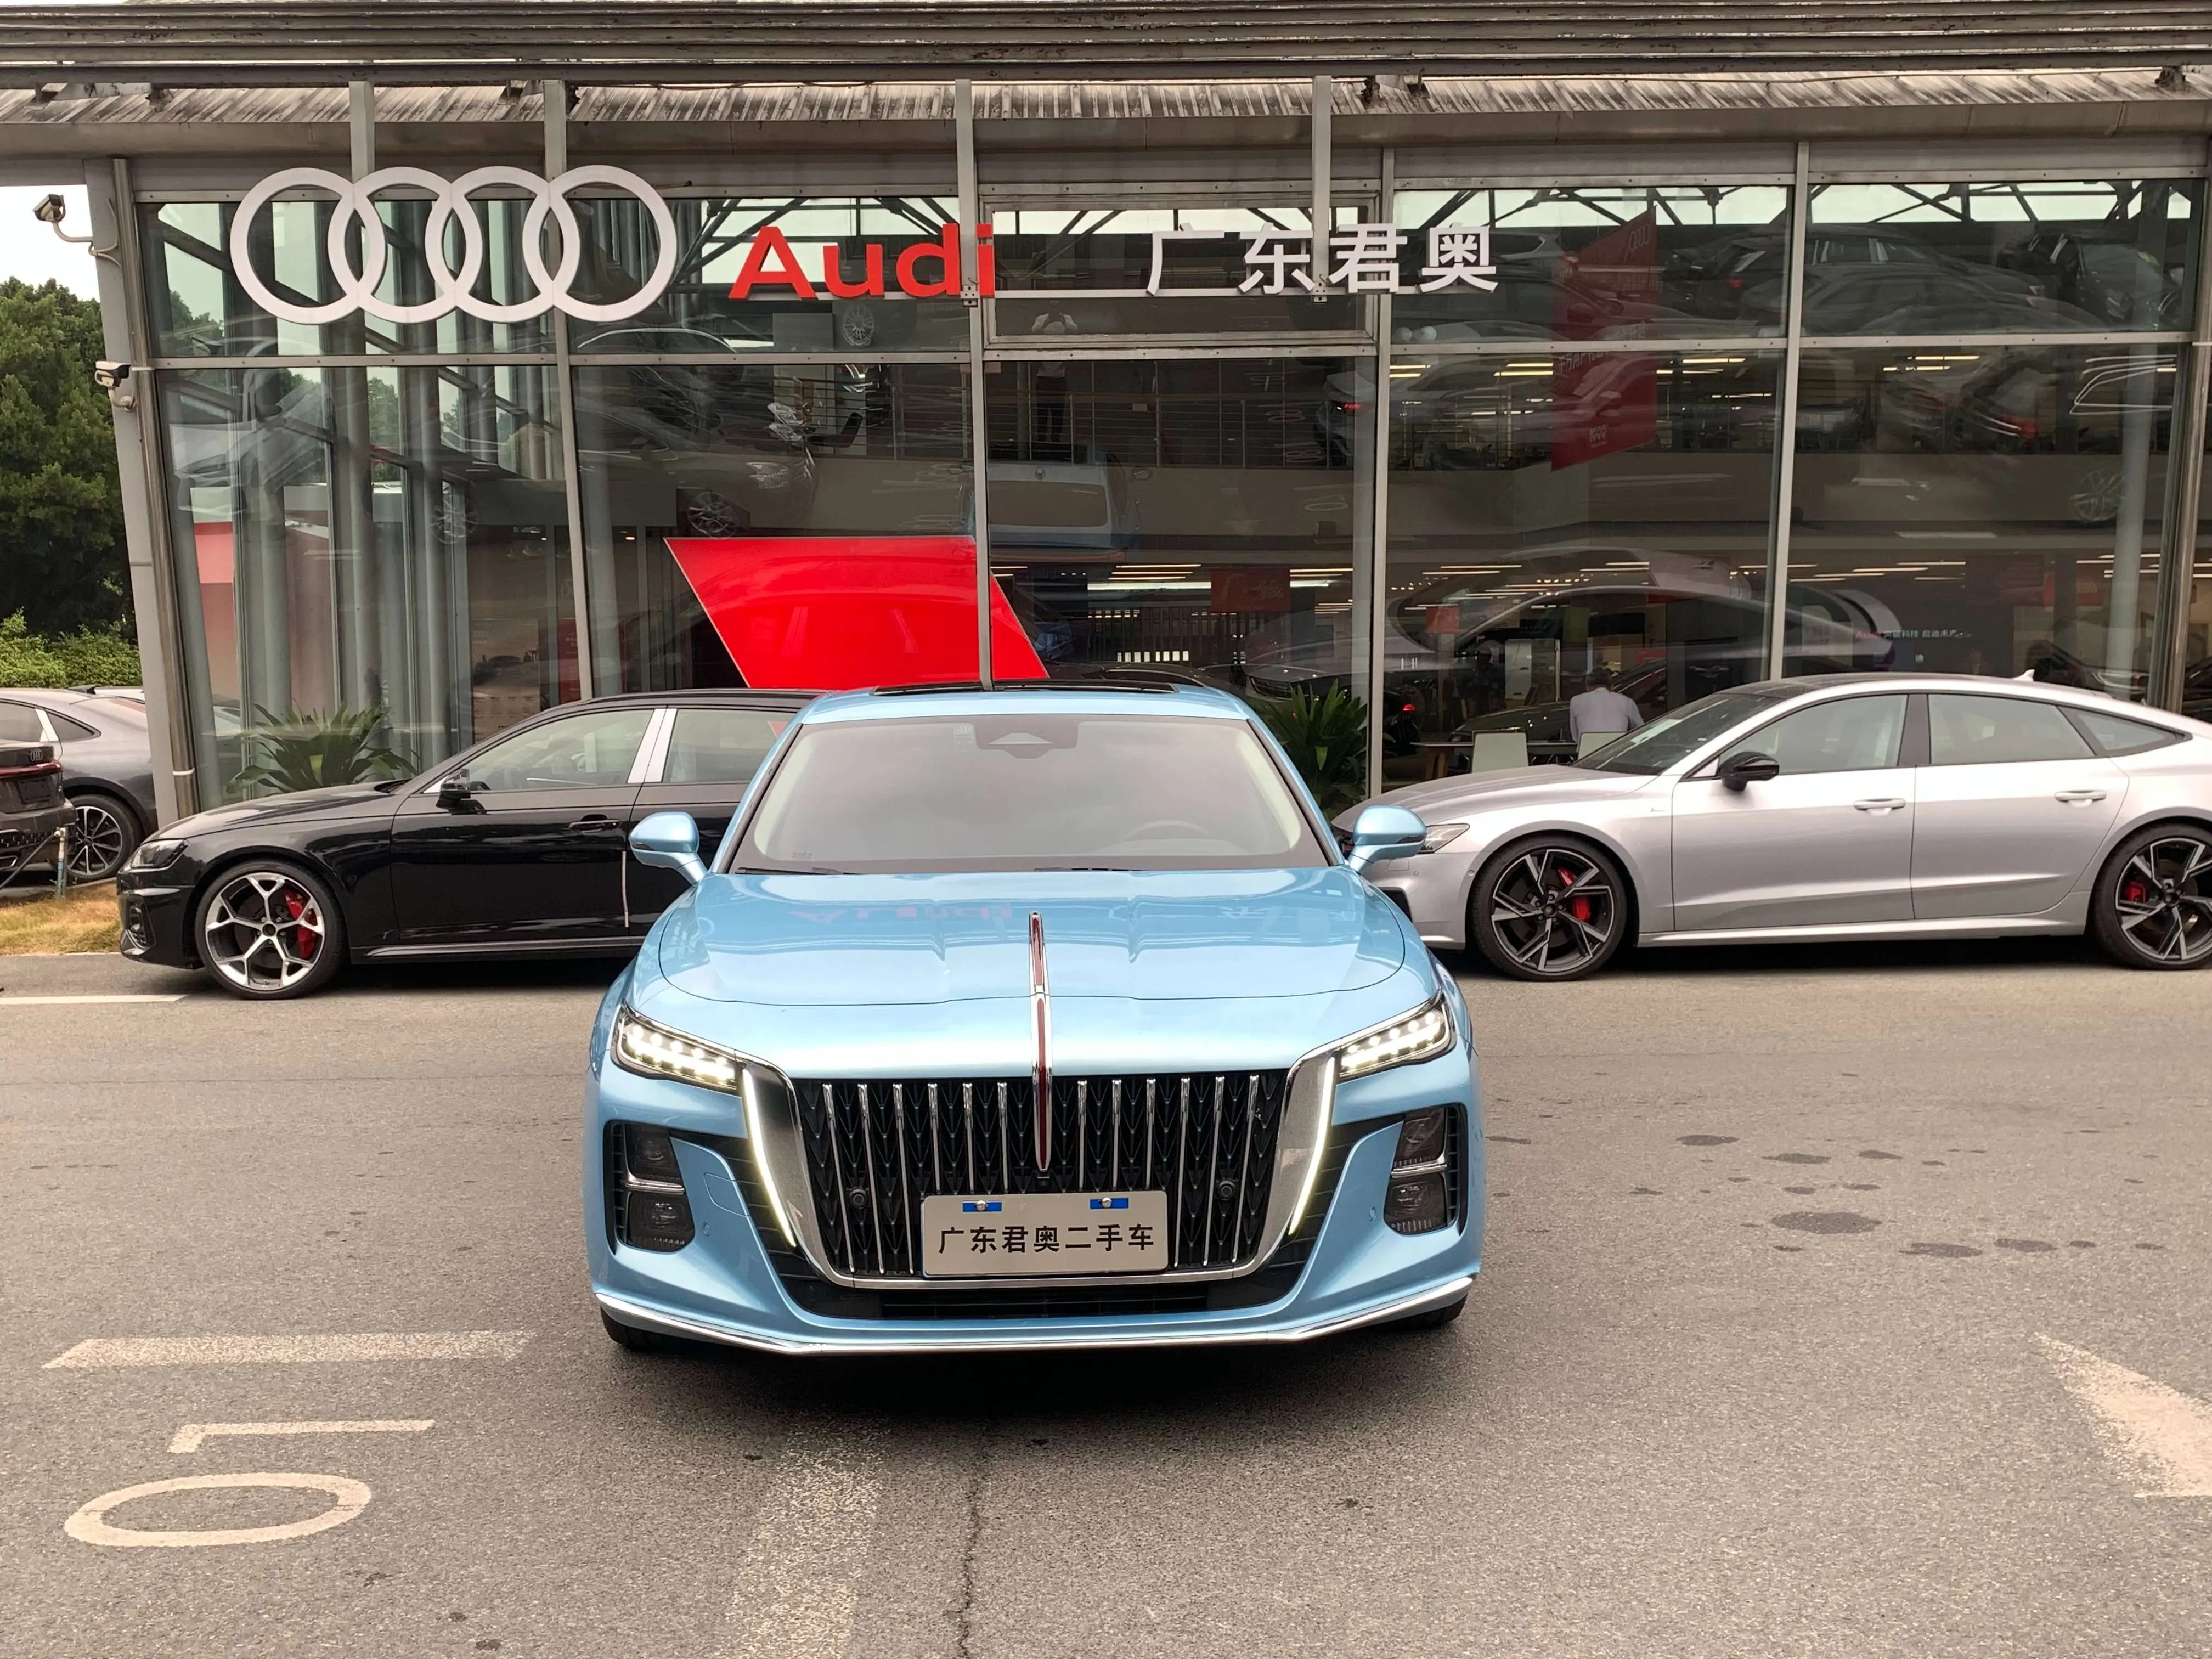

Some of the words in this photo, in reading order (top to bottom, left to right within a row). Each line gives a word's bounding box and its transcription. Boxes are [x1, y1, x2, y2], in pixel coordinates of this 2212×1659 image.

[728, 223, 996, 300] Audi
[1146, 222, 1499, 296] 广东君奥
[938, 1223, 1154, 1254] 广东君奥二手车
